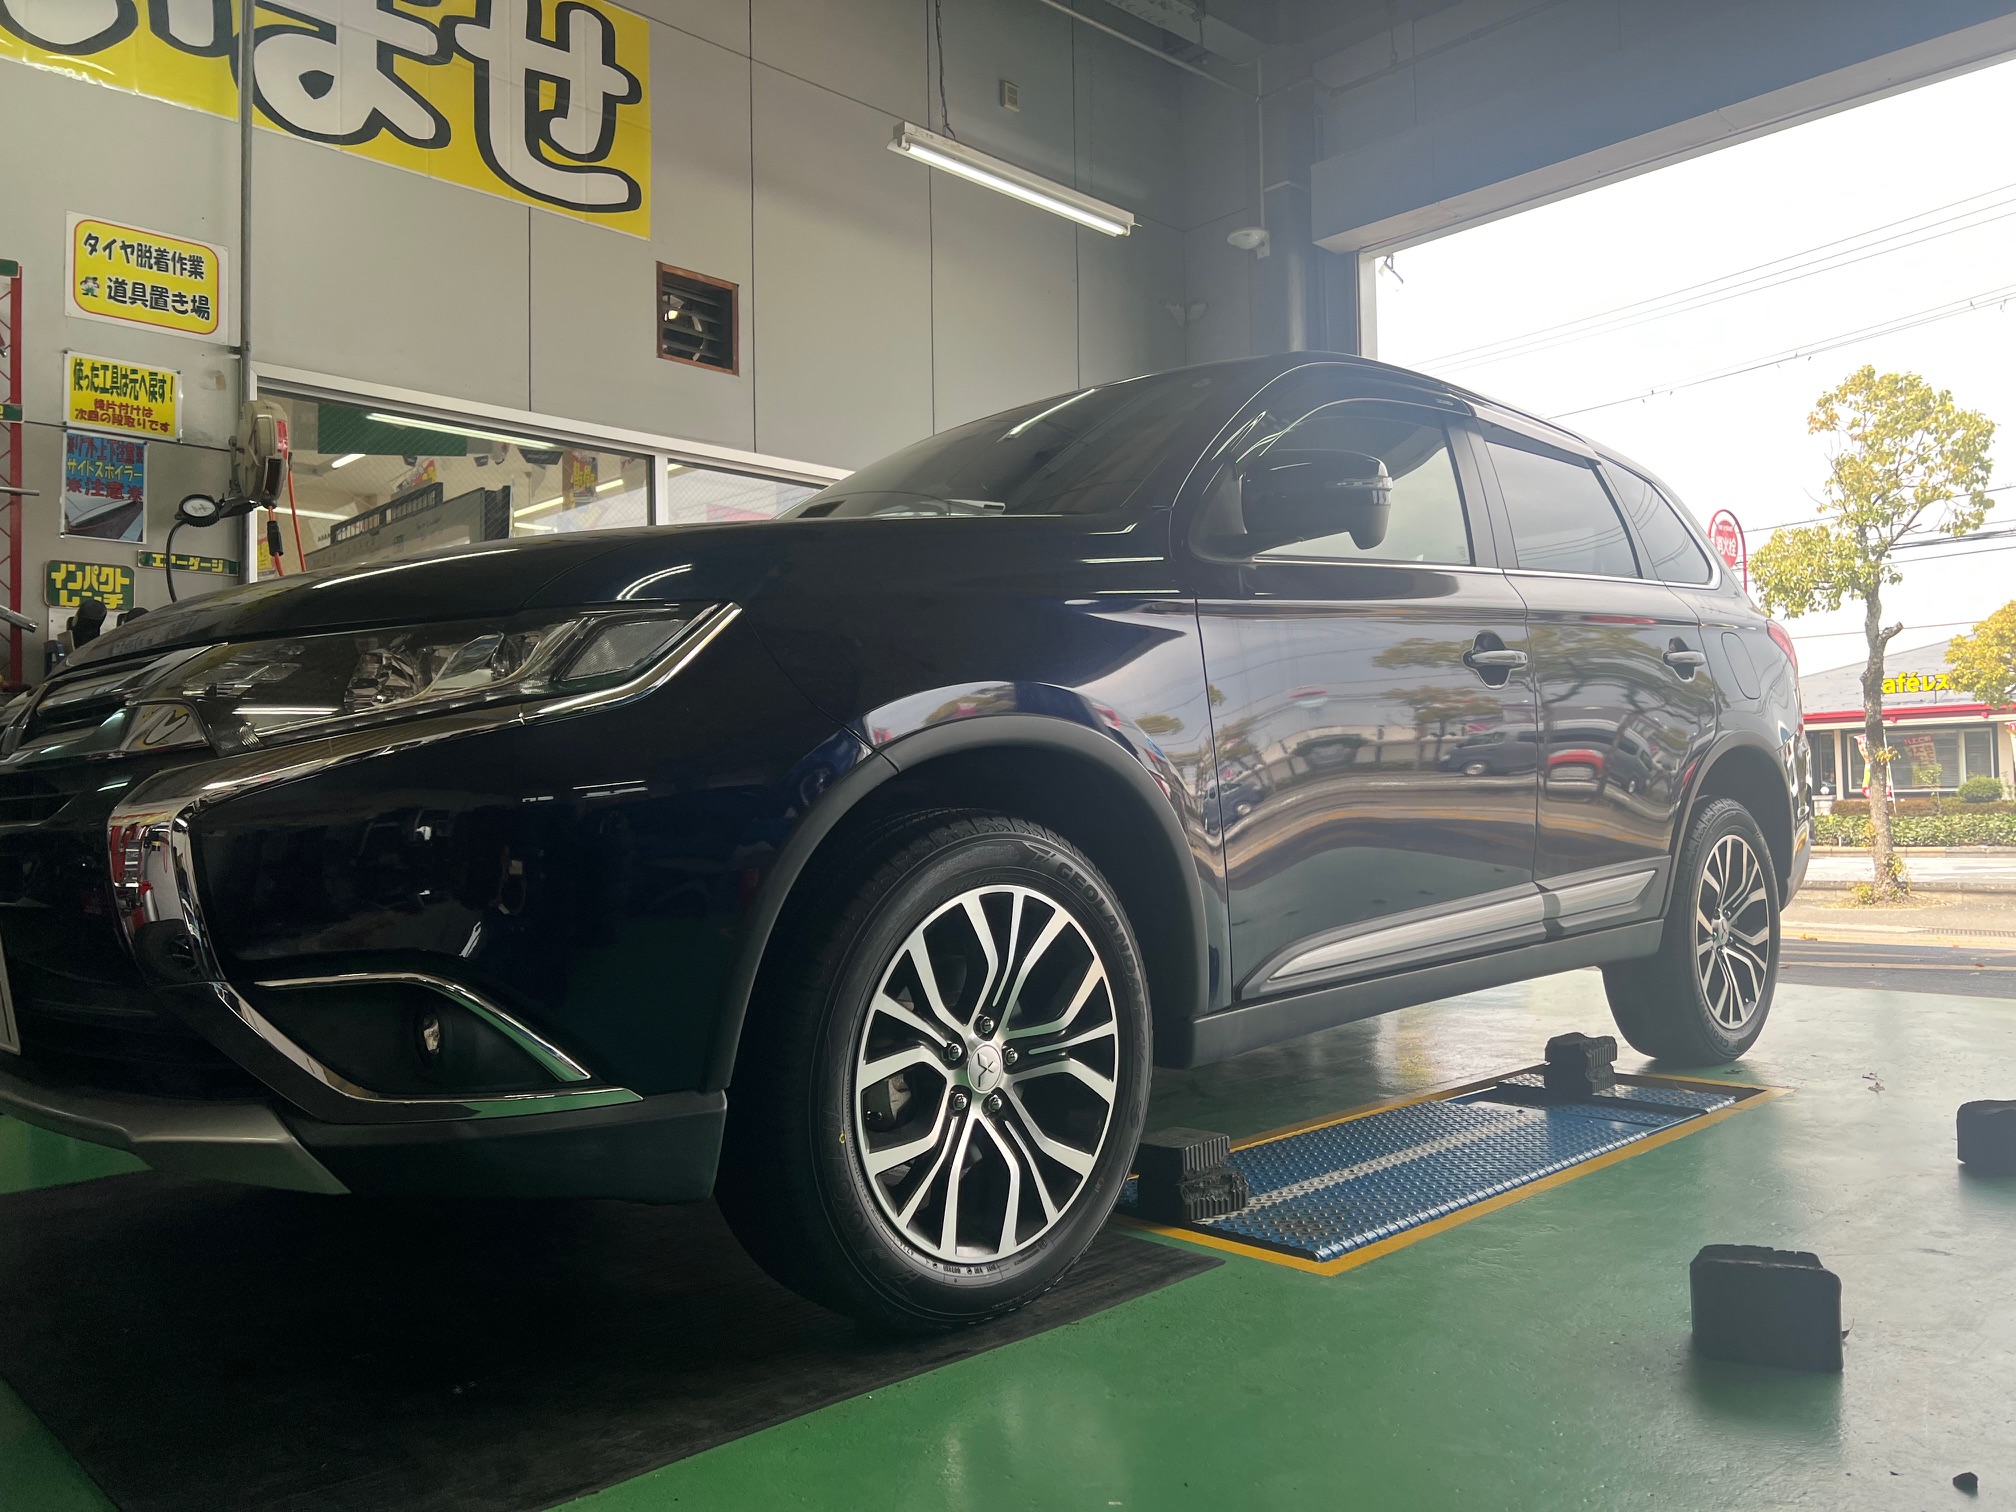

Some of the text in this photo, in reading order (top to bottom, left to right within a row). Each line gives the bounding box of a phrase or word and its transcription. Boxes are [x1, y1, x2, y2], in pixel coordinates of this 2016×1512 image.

[83, 232, 205, 280] タイヤ脱着作業
[106, 276, 211, 321] 道具置き場
[75, 408, 170, 433] 次回の段取りです
[1714, 535, 1738, 557] 消火栓
[51, 563, 130, 593] インパクト
